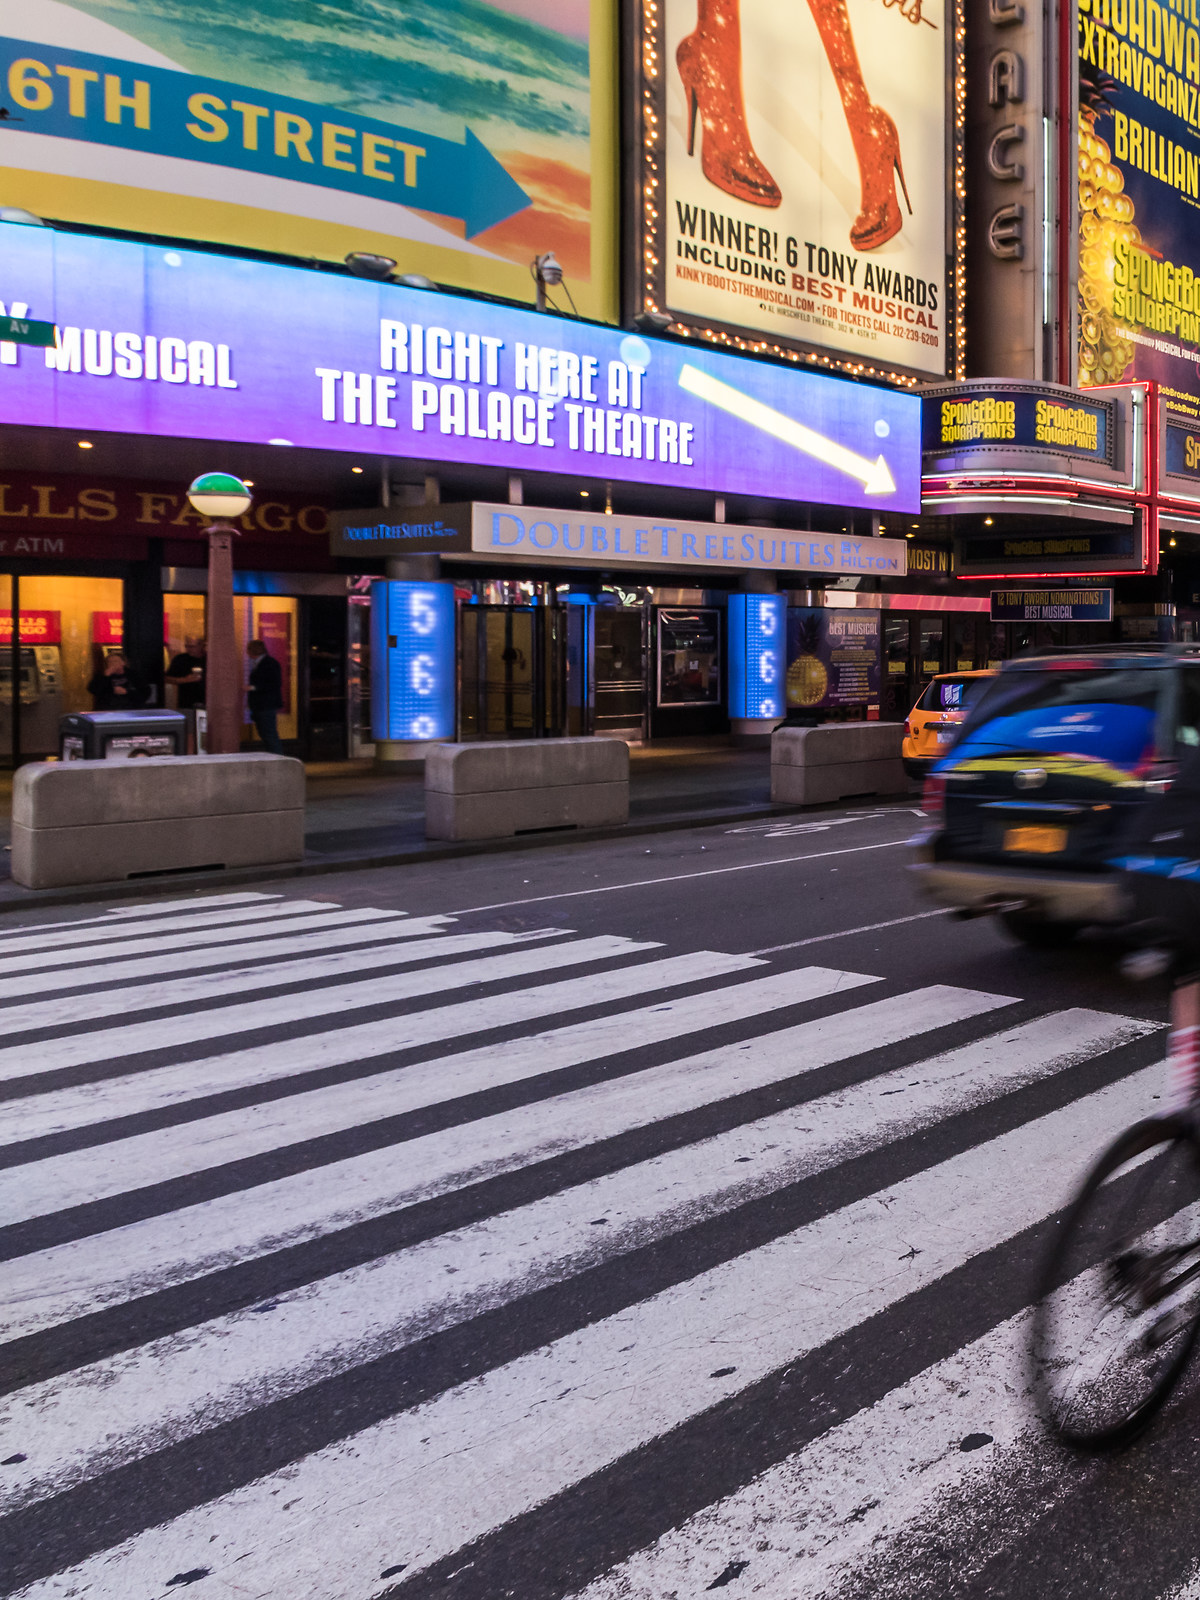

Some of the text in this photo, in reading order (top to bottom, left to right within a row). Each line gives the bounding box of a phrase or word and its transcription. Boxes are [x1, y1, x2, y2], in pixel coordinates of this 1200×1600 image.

[7, 58, 426, 188] 6TH STREET
[675, 200, 938, 311] WINNER! 6 TONY AWARDS
[677, 240, 939, 330] INCLUDING BEST MUSICAL
[676, 264, 939, 348] KINKYBOOTSTHEMUSICAL.COM FOR TICKETS CALL 212-239-6200
[45, 325, 238, 389] MUSICAL
[1155, 338, 1182, 358] MUSICAL
[380, 318, 646, 410] RIGHT HERE AT
[315, 367, 694, 466] THE PALACE THEATRE
[941, 398, 1016, 426] SPONGEBOB
[1036, 400, 1097, 435] SPONGEBOB
[941, 422, 1016, 443] SQUAREPANTS
[1036, 424, 1097, 450] SQUAREPANTS
[136, 491, 330, 535] FAGO
[14, 537, 64, 553] ATM
[841, 540, 862, 555] BY
[841, 553, 898, 571] HILTON
[907, 550, 938, 571] MOST
[1006, 593, 1023, 606] TONY
[1024, 592, 1049, 605] AWARD
[1025, 605, 1073, 619] BEST MUSICAL
[847, 623, 878, 636] MUSICAL
